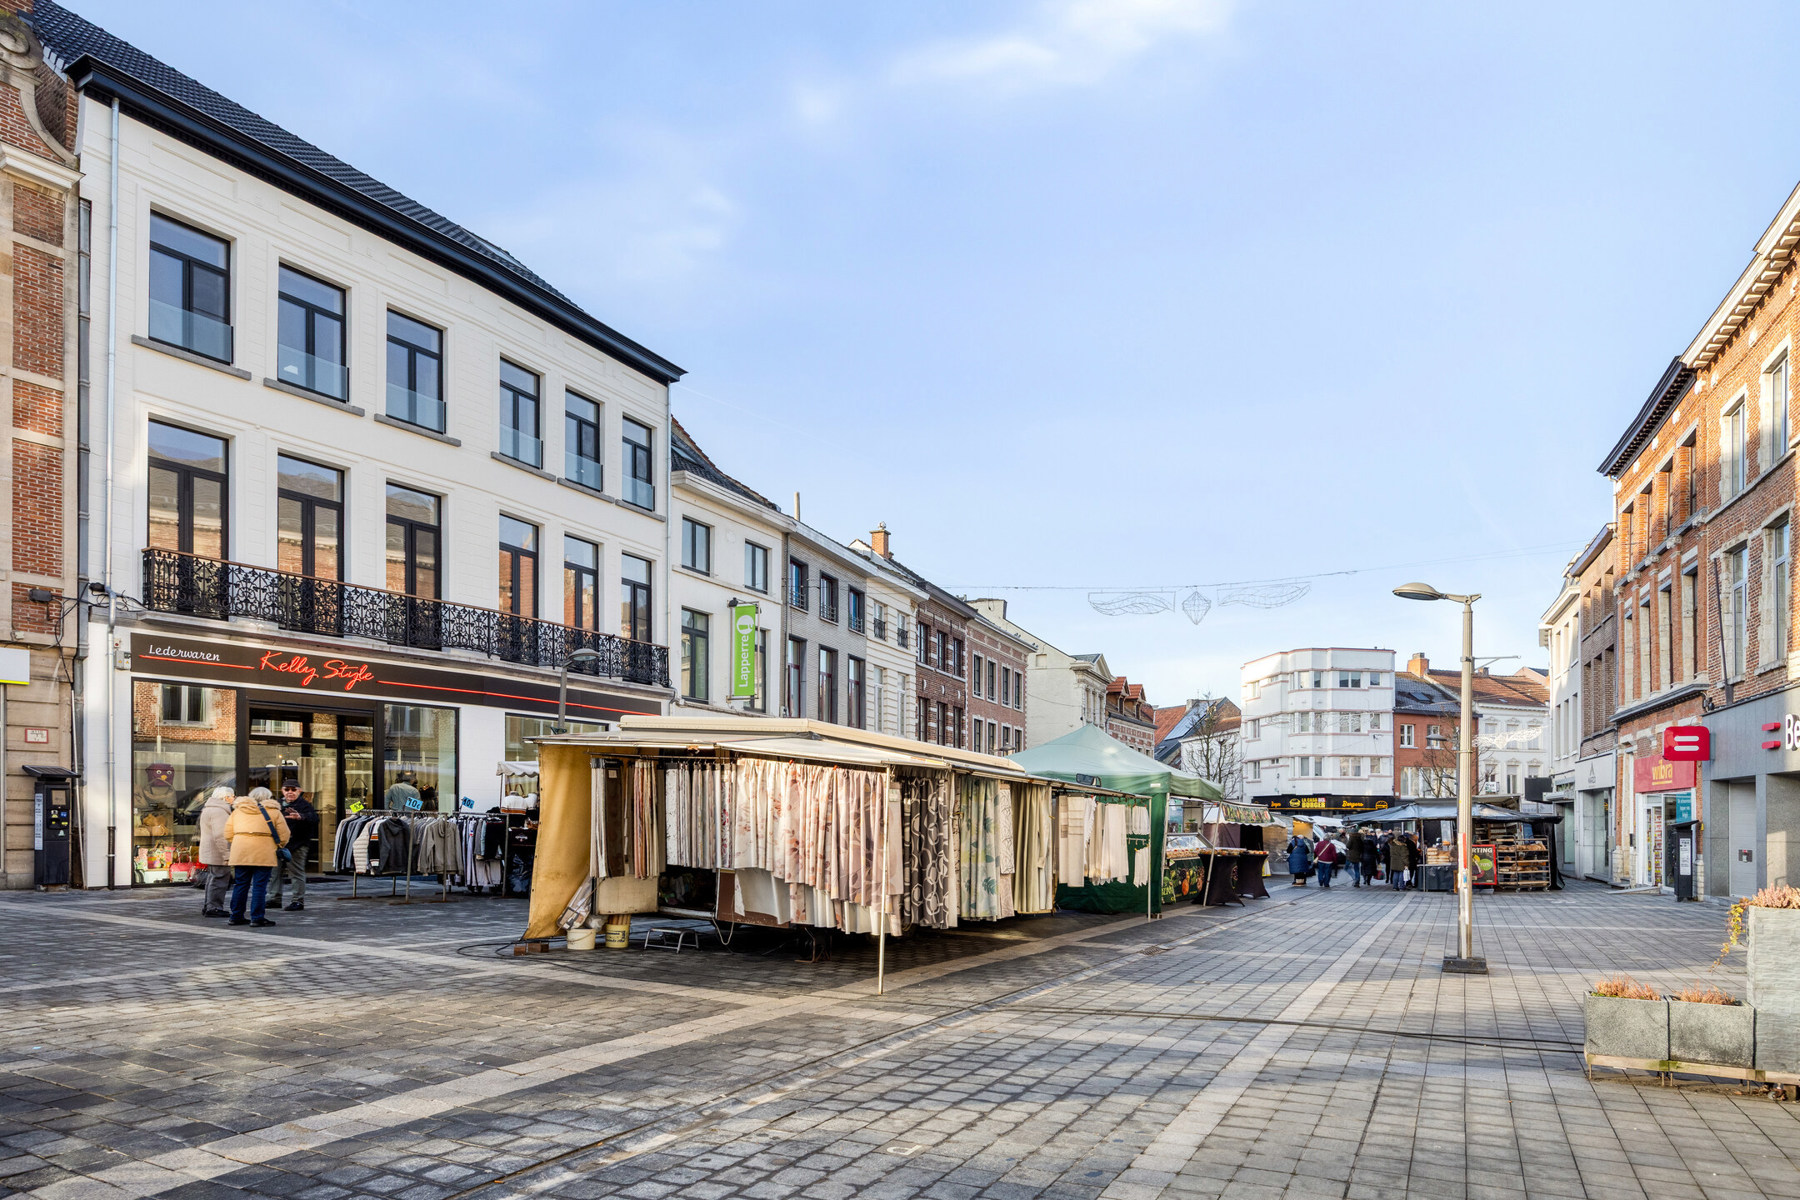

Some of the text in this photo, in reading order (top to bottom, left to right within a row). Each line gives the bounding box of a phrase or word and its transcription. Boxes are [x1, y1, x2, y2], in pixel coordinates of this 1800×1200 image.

[149, 644, 220, 662] Lederwaren
[739, 635, 750, 687] Lapperre
[260, 651, 374, 691] Kelly Style
[1652, 760, 1673, 780] wibra
